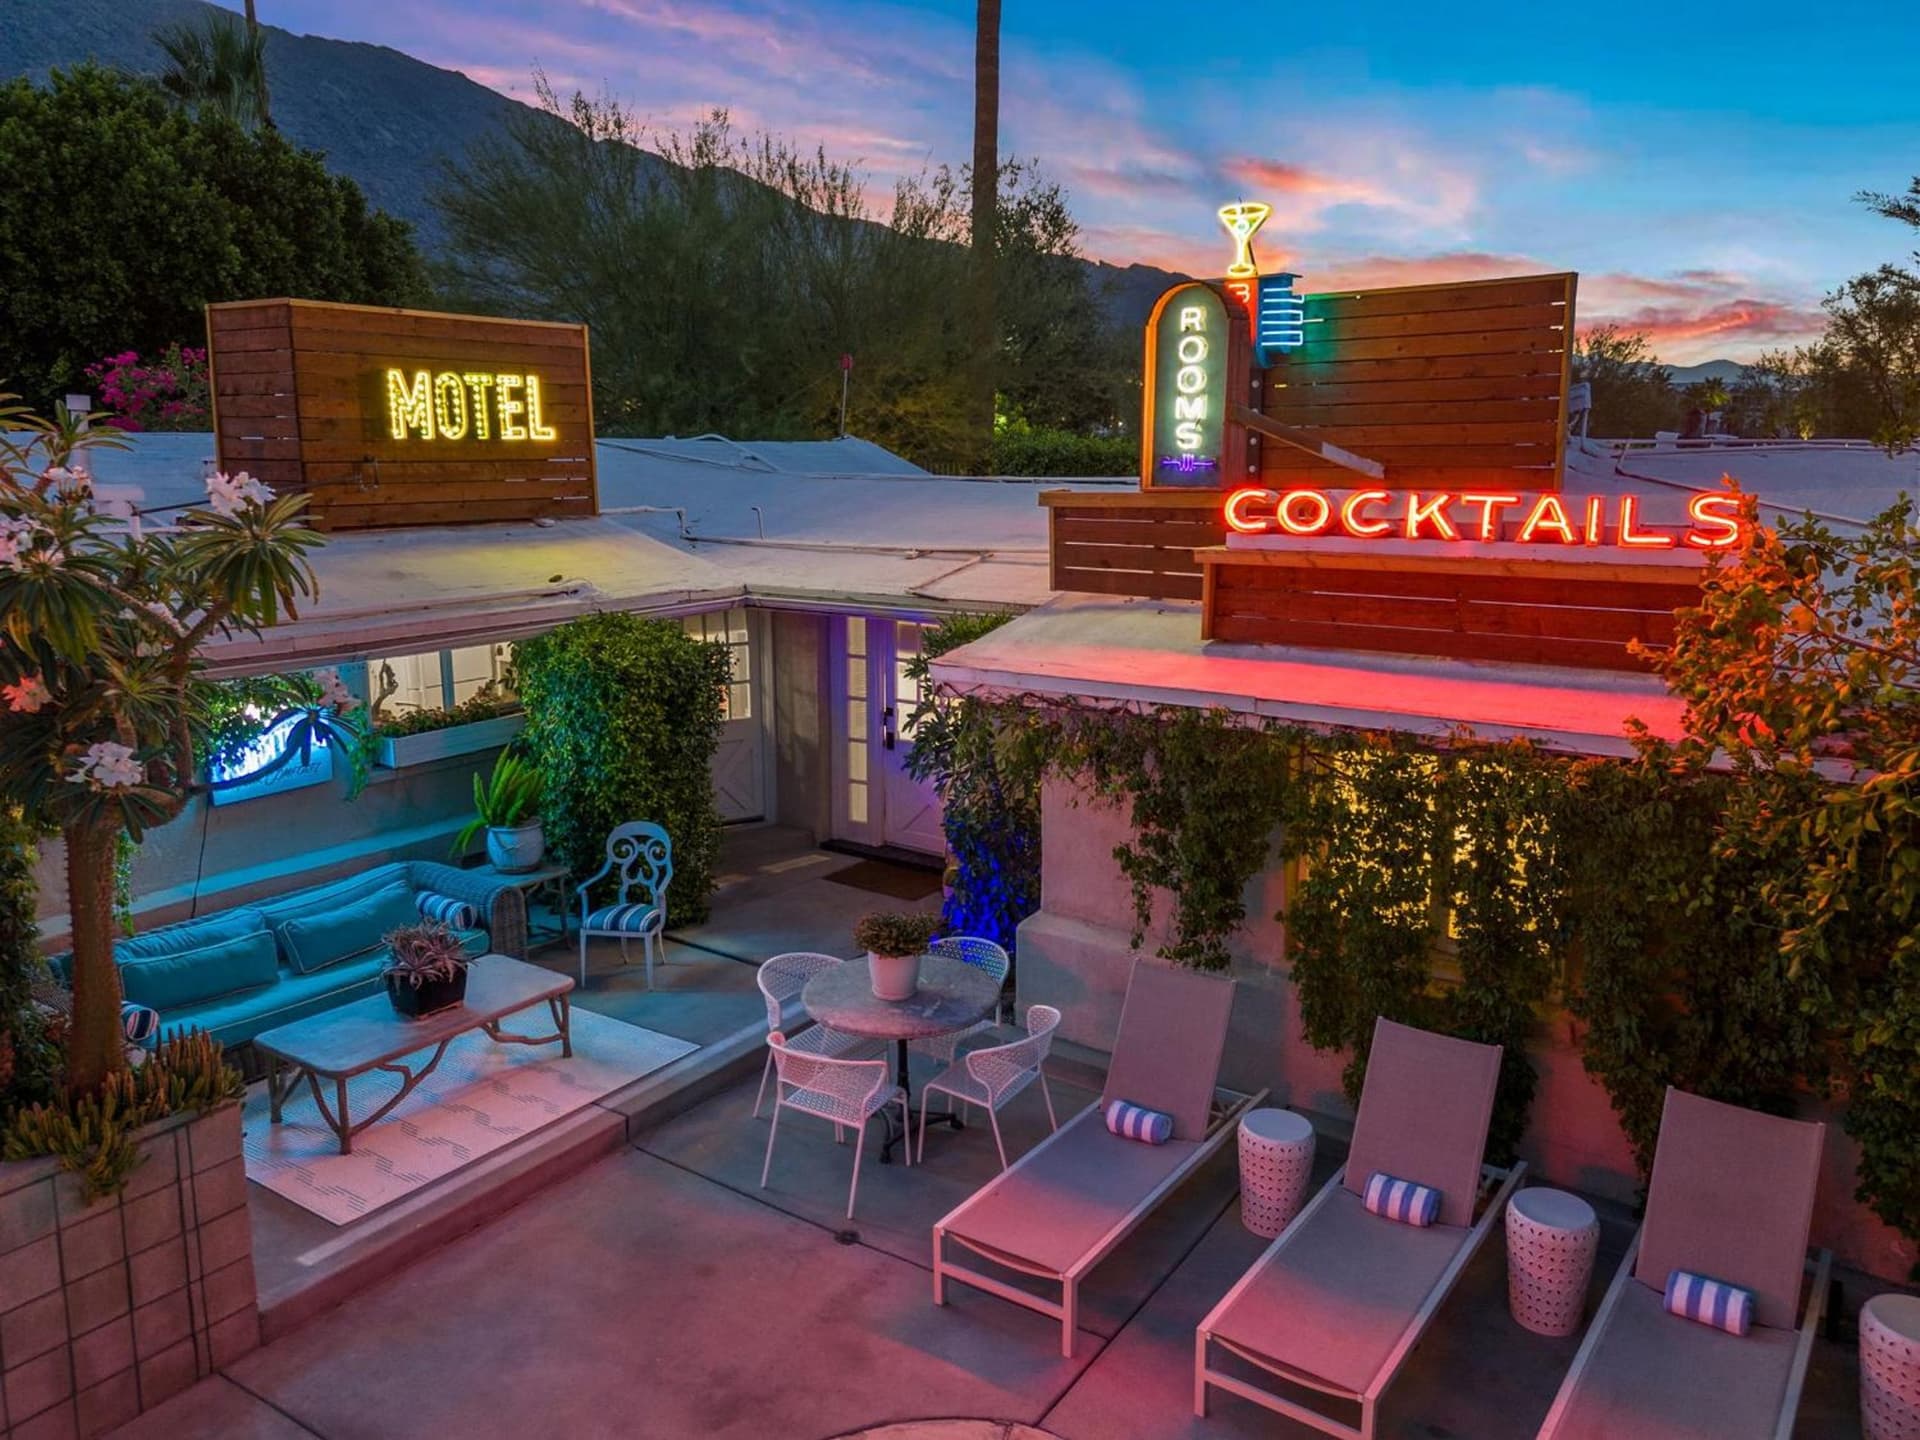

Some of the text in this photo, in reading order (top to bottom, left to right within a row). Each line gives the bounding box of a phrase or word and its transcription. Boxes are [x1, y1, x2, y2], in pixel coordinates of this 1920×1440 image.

[386, 368, 556, 440] MOTEL
[1175, 306, 1208, 450] ROOMS
[1223, 488, 1742, 549] COCKTAILS
